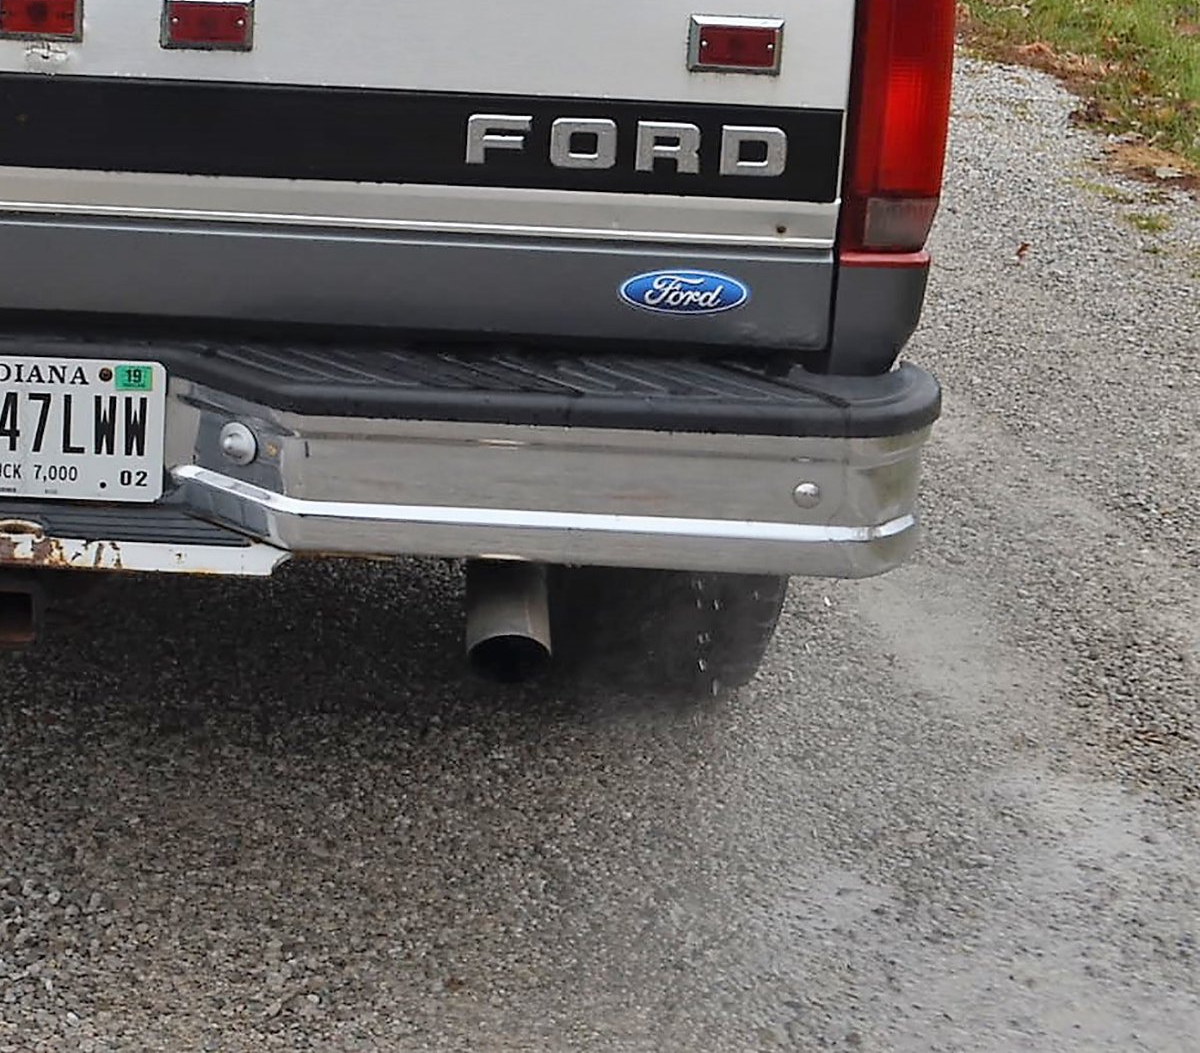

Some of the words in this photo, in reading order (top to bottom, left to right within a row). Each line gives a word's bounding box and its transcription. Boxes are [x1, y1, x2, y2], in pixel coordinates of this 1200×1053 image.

[465, 112, 789, 178] FORD
[645, 275, 725, 308] Ford
[125, 368, 143, 384] 19
[33, 464, 78, 482] 7,000
[119, 470, 148, 487] 02
